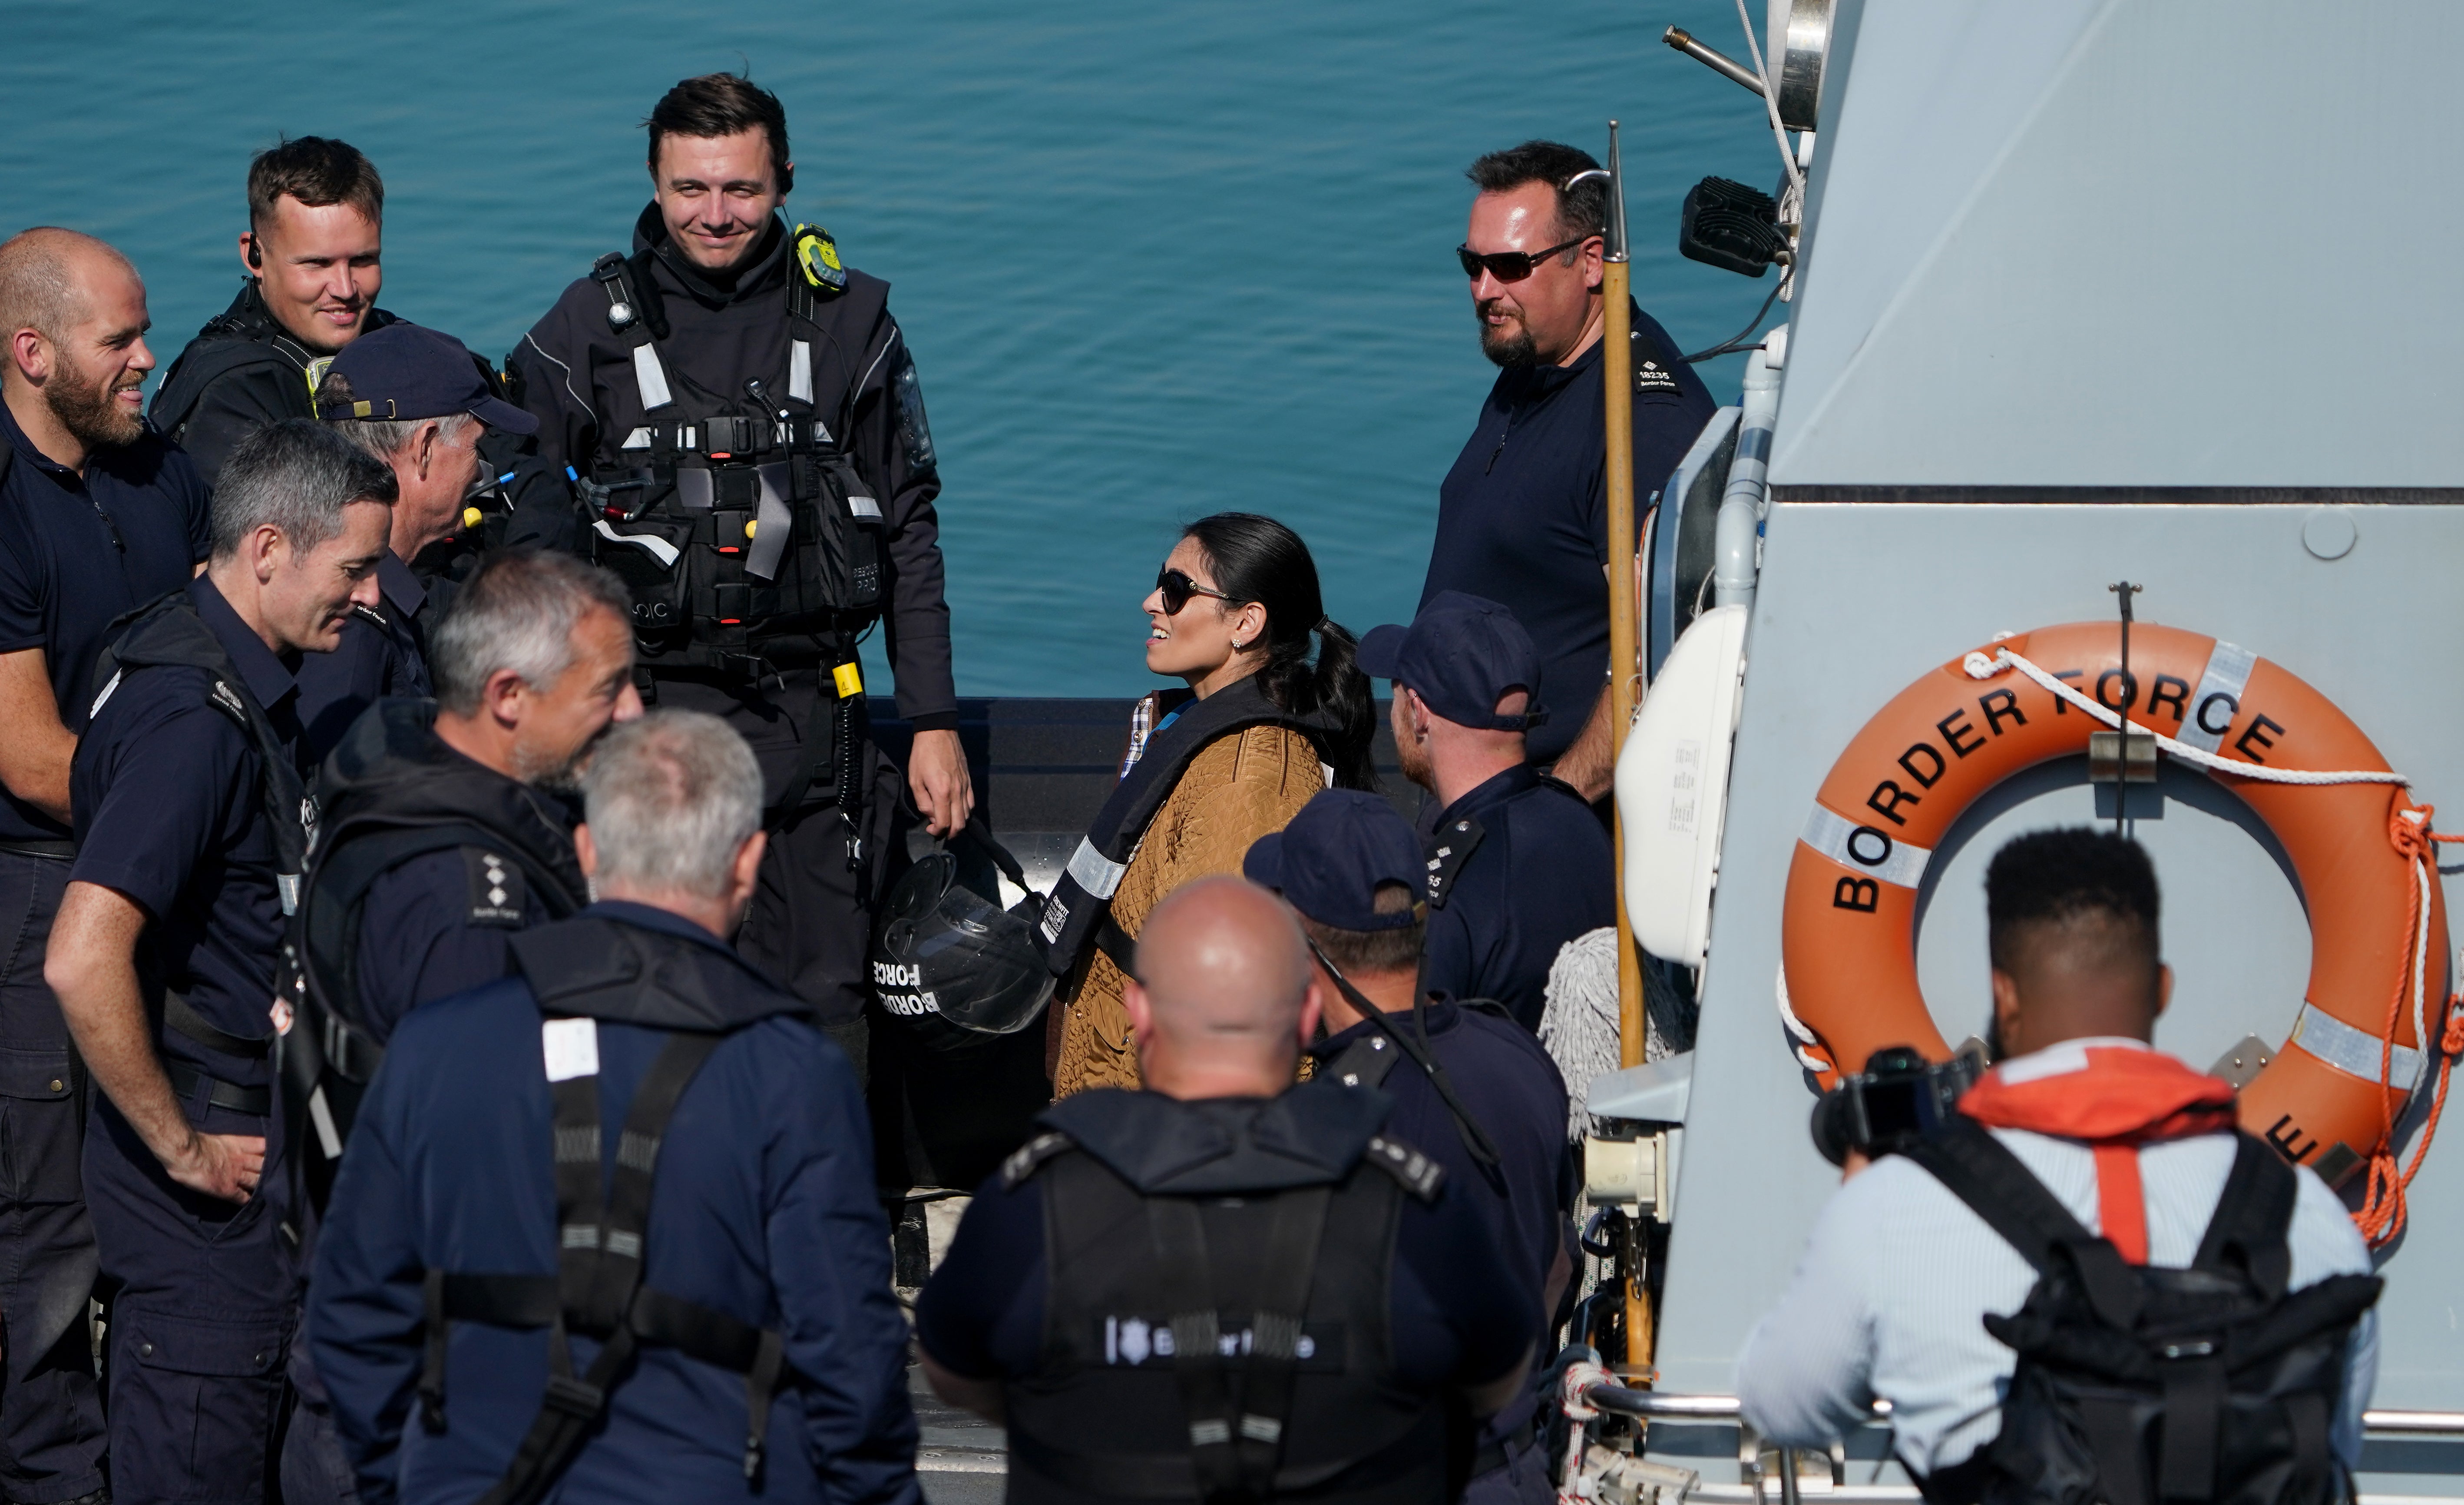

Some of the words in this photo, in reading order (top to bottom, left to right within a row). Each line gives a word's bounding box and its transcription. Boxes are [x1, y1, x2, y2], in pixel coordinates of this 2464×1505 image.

[1639, 371, 1670, 379] 18235
[857, 577, 876, 594] PRO
[357, 605, 372, 615] order
[841, 681, 849, 694] 4
[1832, 688, 2029, 913] BORDER
[2054, 669, 2286, 767] FORCE
[1053, 895, 1069, 916] CREWFIT
[873, 961, 921, 986] FORCE
[876, 988, 941, 1015] BORDE
